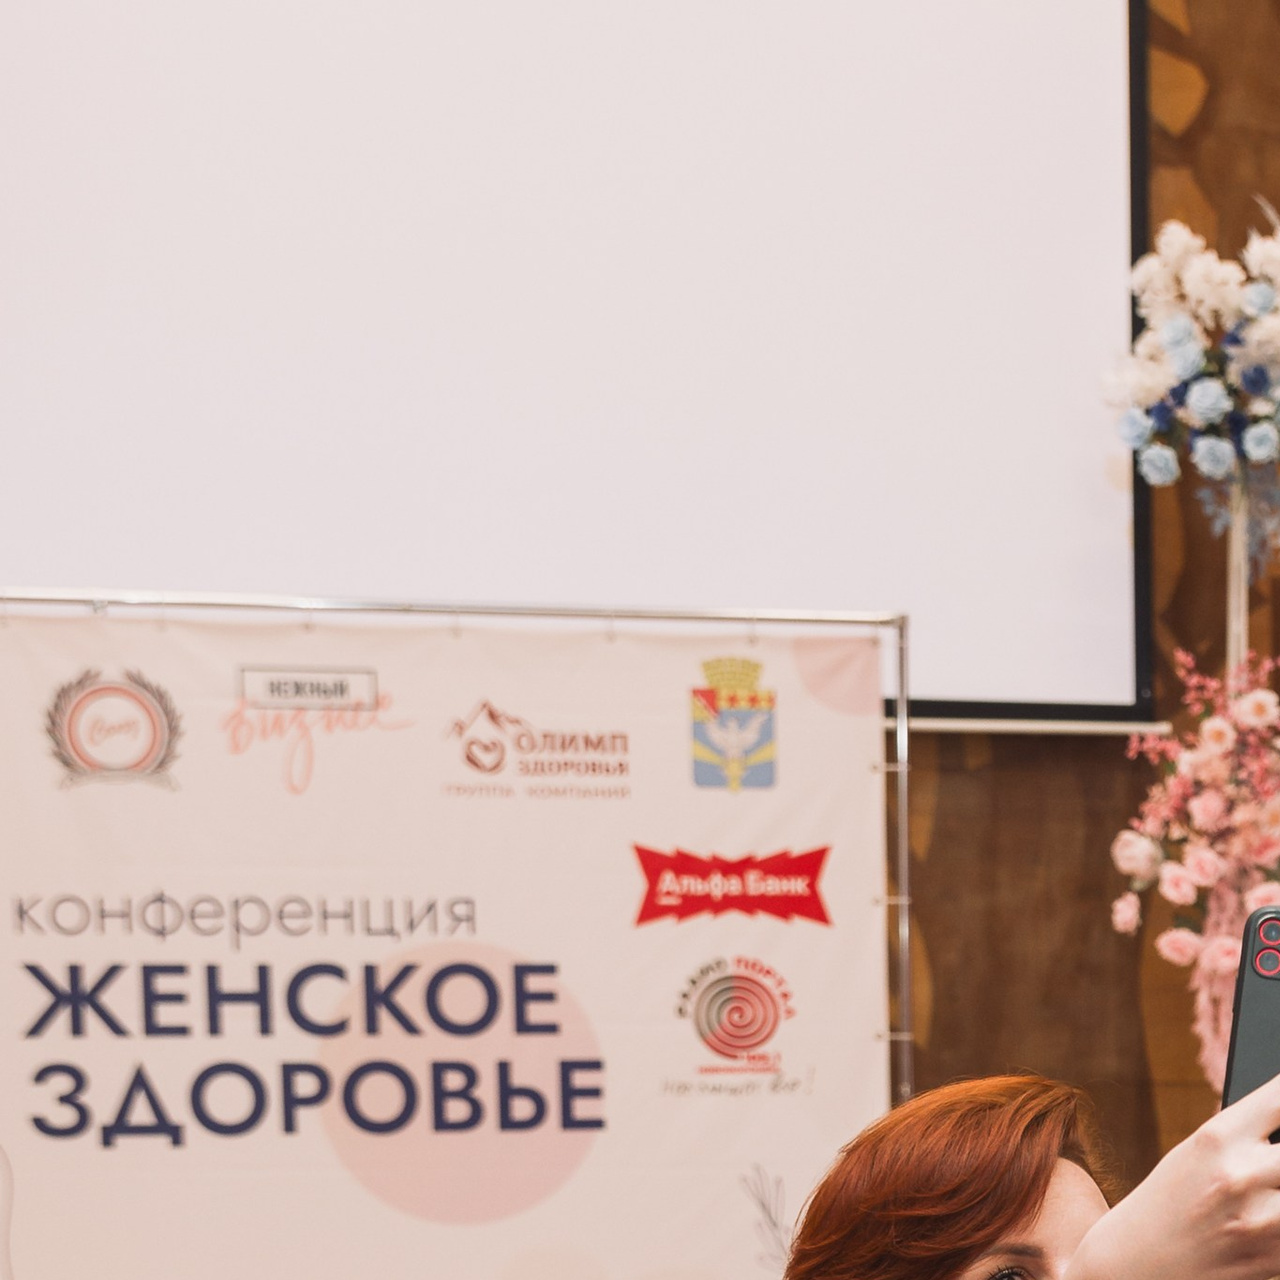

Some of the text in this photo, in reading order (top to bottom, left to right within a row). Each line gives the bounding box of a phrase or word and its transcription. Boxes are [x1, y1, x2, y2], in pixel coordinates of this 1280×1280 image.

[515, 730, 629, 755] ОЛИМП
[517, 760, 629, 777] ЗДОРОВЬЯ
[655, 868, 811, 905] Альфа Банк
[14, 889, 478, 952] конференция
[23, 962, 560, 1038] ЖЕНСКОЕ
[31, 1060, 605, 1148] ЗДОРОВЬЕ
